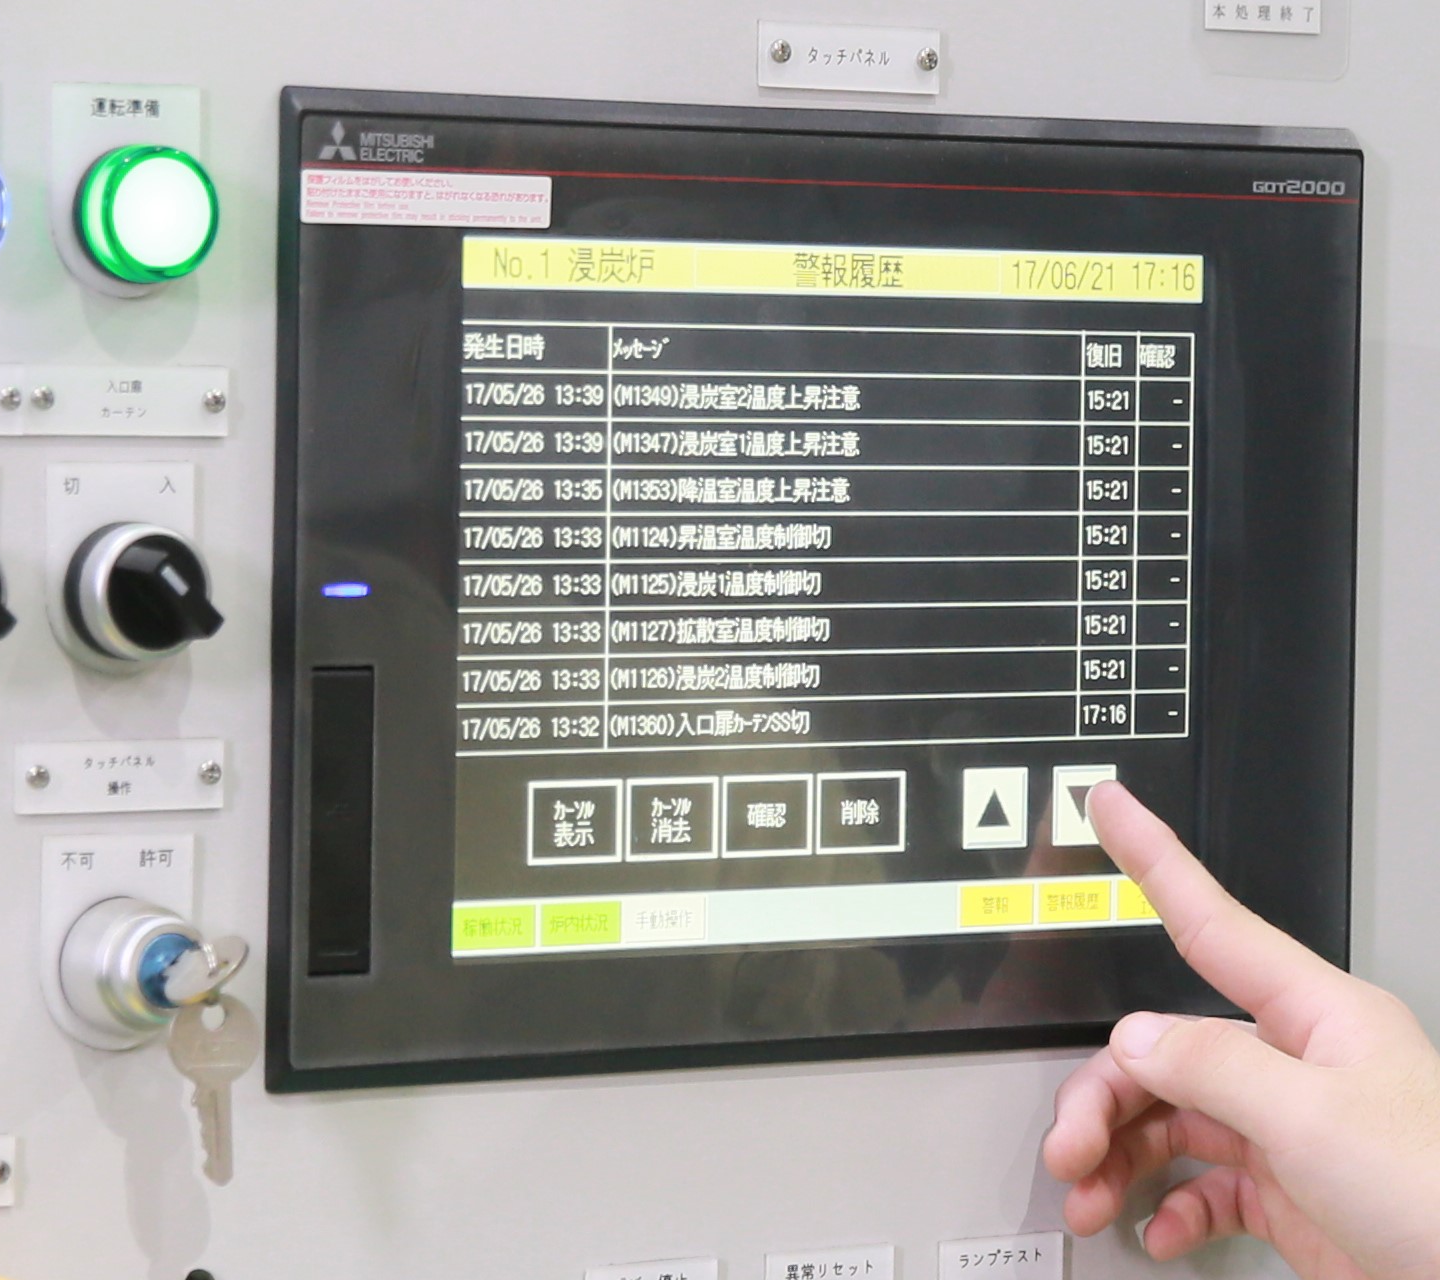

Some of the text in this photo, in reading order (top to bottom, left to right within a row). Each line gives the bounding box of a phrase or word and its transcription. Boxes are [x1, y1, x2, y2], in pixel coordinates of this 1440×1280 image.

[1213, 4, 1314, 23] 本処理終了
[808, 47, 890, 67] タッチパネル
[91, 97, 160, 118] 運転準備
[360, 132, 435, 150] MITSUBISHI
[360, 148, 424, 163] ELECTRIC
[1252, 180, 1345, 196] GOT2000
[493, 247, 655, 283] No.1 浸炭炉
[793, 252, 904, 289] 警報履歴
[1012, 260, 1196, 292] 17/06/21 17:16
[463, 333, 545, 360] 発生日時
[1086, 343, 1122, 369] 復旧
[1139, 343, 1176, 369] 確認
[106, 379, 143, 394] 入口扉
[465, 383, 544, 407] 17/05/26
[555, 384, 604, 406] 13:39
[614, 384, 860, 411] (M1349)浸炭室2温度上昇注意
[1087, 390, 1130, 412] 15:21
[101, 406, 146, 419] カーテン
[464, 431, 544, 454] 17/05/26
[554, 431, 603, 453] 13:39
[613, 431, 860, 457] (M1347)浸炭室1温度上昇注意
[1086, 434, 1129, 456] 15:21
[63, 476, 176, 495] 切 入
[464, 478, 544, 502] 17/05/26
[553, 479, 603, 501] 13:35
[613, 478, 851, 504] (M1353)降温室温度上昇注意
[1086, 480, 1129, 501] 15:21
[463, 525, 544, 549] 17/05/26
[553, 526, 603, 548] 13:33
[612, 524, 832, 550] (M1124)昇温室温度制御切
[1085, 524, 1128, 546] 15:21
[463, 574, 543, 597] 17/05/26
[553, 574, 602, 596] 13:33
[611, 571, 822, 597] (M1125)浸炭1温度制御切
[1084, 569, 1128, 591] 15:21
[462, 622, 542, 645] 17/05/26
[552, 622, 601, 644] 13:33
[611, 618, 830, 643] (M1127)拡散室温度制御切
[1084, 614, 1127, 635] 15:21
[462, 669, 541, 693] 17/05/26
[552, 669, 601, 691] 13:33
[610, 664, 820, 691] (M1126)浸炭2温度制御切
[1083, 659, 1126, 680] 15:21
[461, 717, 541, 741] 17/05/26
[551, 717, 600, 738] 13:32
[1082, 704, 1127, 726] 17:16
[84, 756, 156, 769] タッチパネル
[107, 781, 133, 796] 操作
[746, 802, 787, 829] 確認
[839, 798, 880, 827] 削除
[553, 821, 595, 848] 表示
[651, 818, 692, 844] 消去
[61, 848, 174, 870] 不可 許可
[1046, 892, 1099, 912] 警報履歴
[549, 913, 609, 934] 炉内状況
[635, 910, 693, 931] 手動操作
[959, 1247, 1044, 1269] ランプテスト
